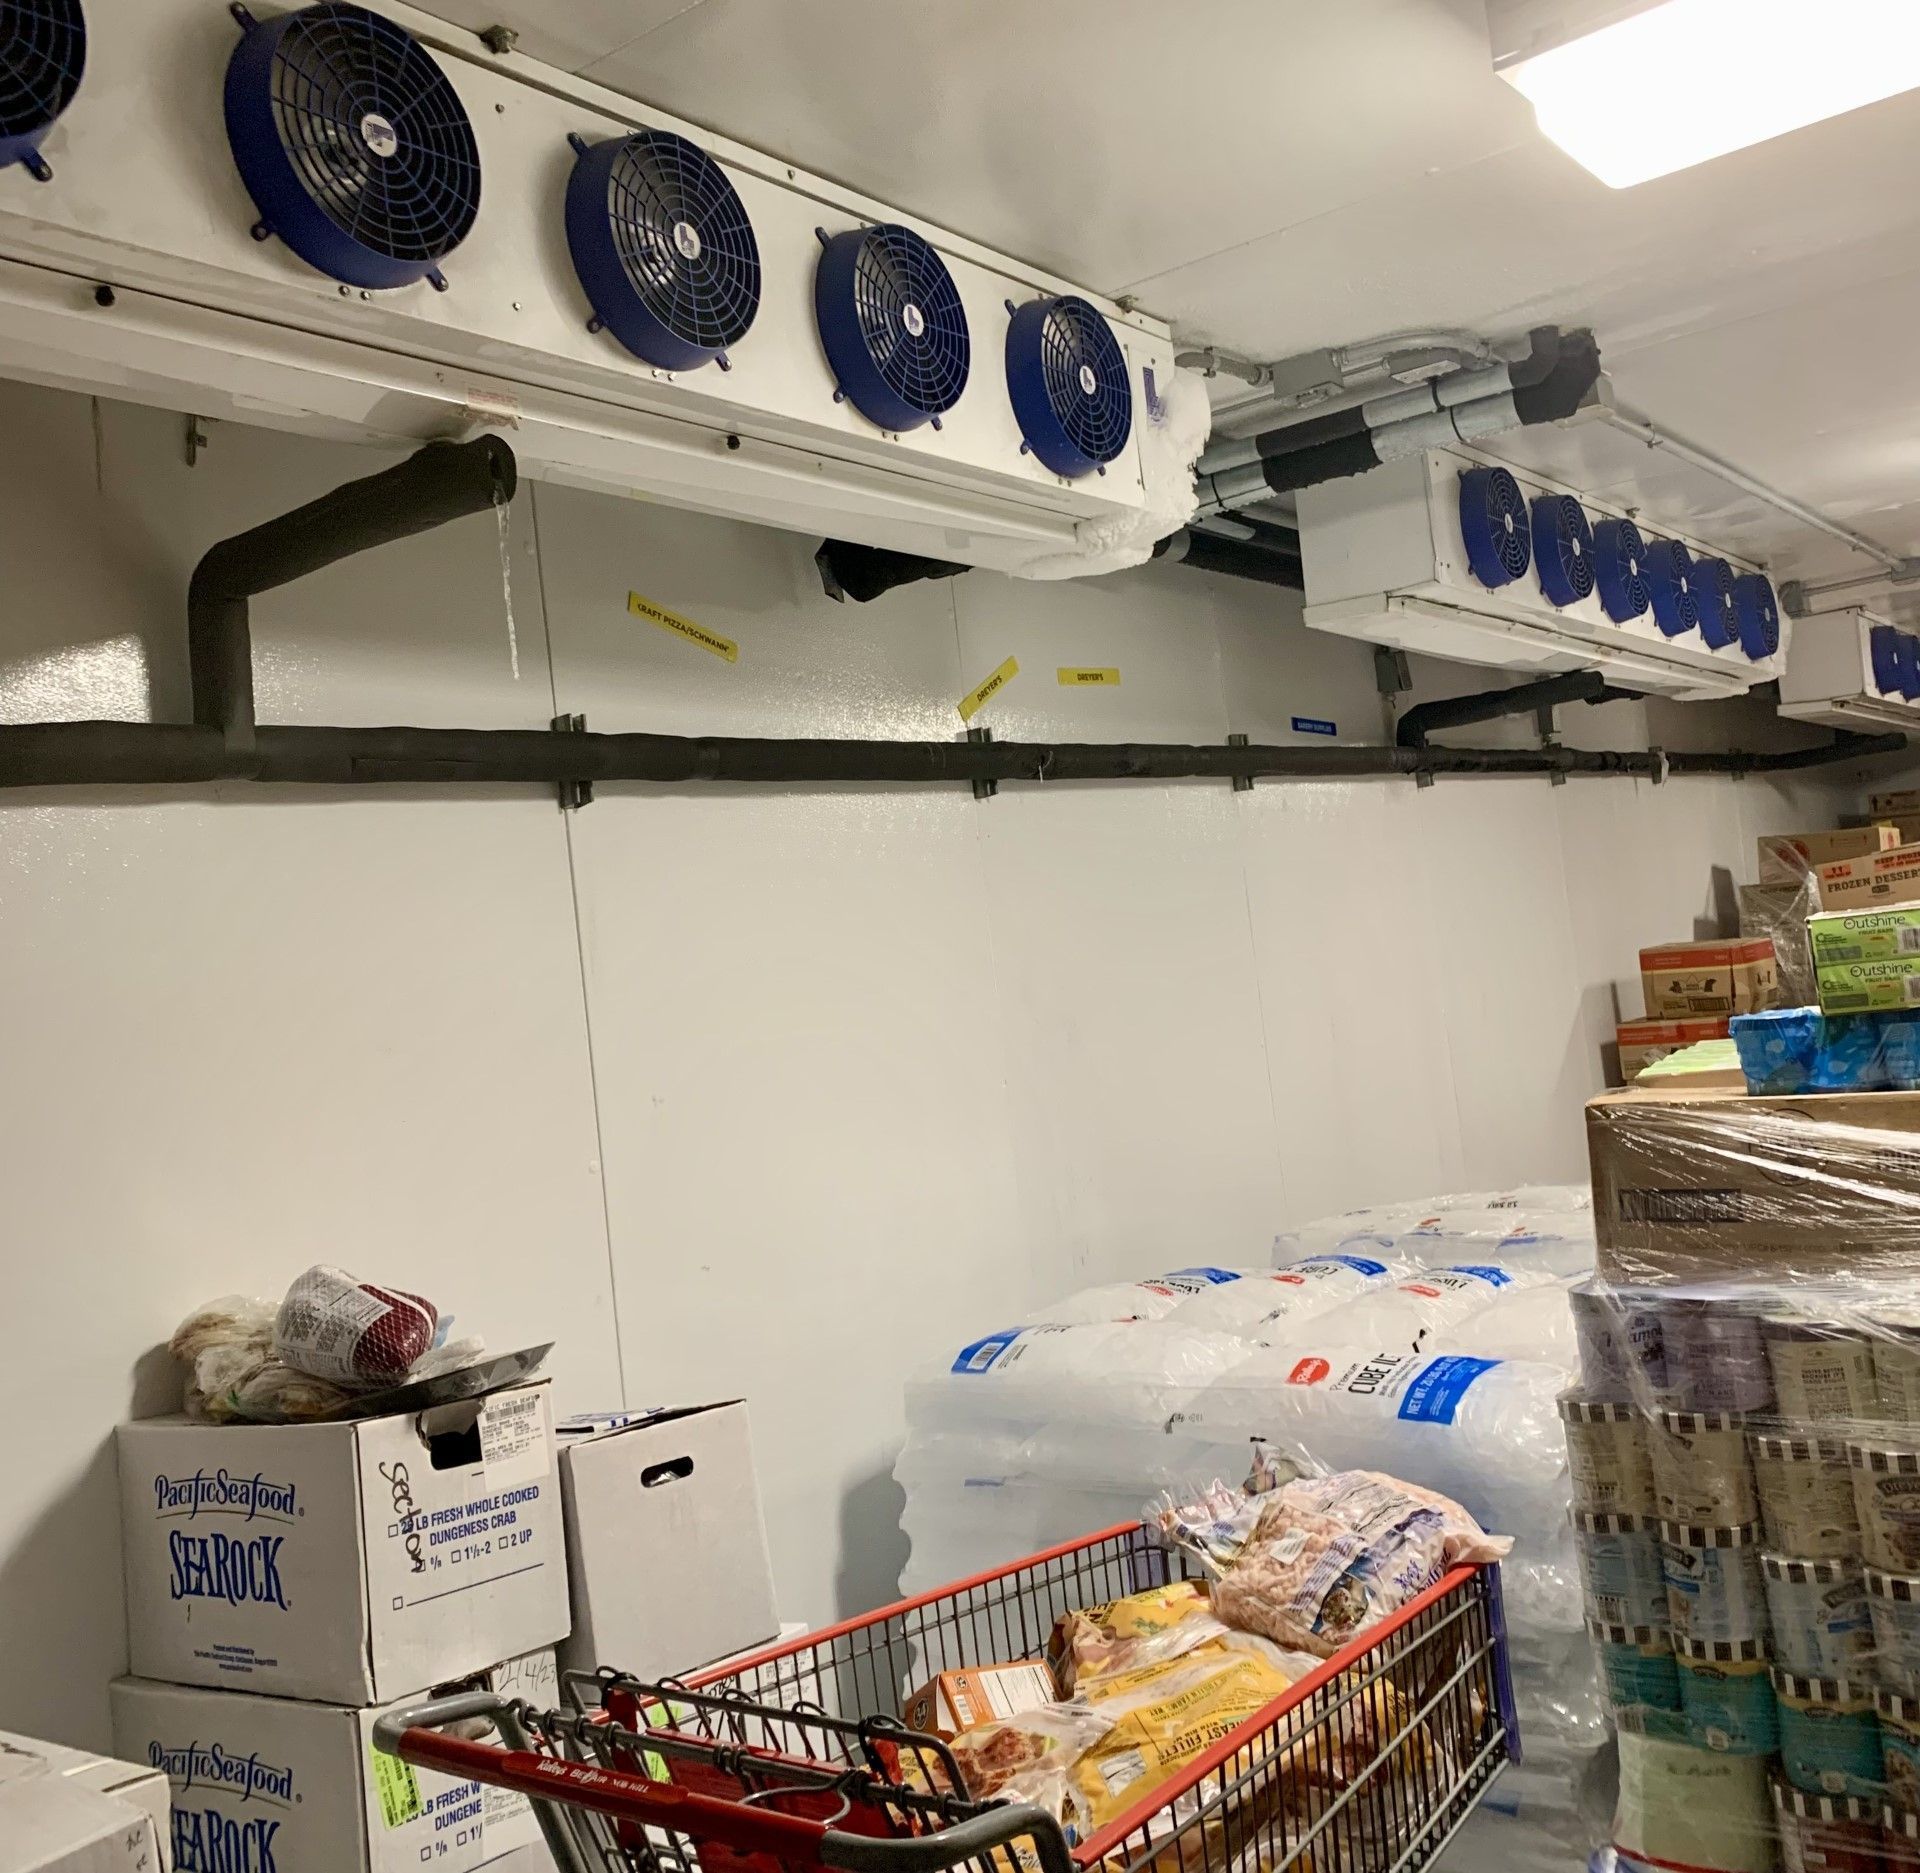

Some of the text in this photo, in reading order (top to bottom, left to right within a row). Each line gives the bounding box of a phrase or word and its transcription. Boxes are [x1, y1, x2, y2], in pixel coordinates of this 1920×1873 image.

[977, 674, 1003, 702] DREYER'S
[1077, 672, 1104, 682] DREYER'S
[1828, 876, 1871, 893] FROZEN
[1844, 915, 1905, 930] Outshine
[1850, 963, 1913, 978] Outshine
[1347, 1363, 1392, 1395] CUBE
[416, 1516, 429, 1531] LB
[431, 1506, 464, 1527] FRESH
[465, 1495, 501, 1518] WHOLE
[501, 1485, 540, 1508] COOKED
[429, 1510, 517, 1547] DUNGENESS CRAB
[510, 1533, 518, 1547] 2
[519, 1528, 533, 1544] UP
[169, 1529, 288, 1612] SEAROCK
[436, 1786, 469, 1811] FRESH
[435, 1800, 482, 1832] DUNGENE
